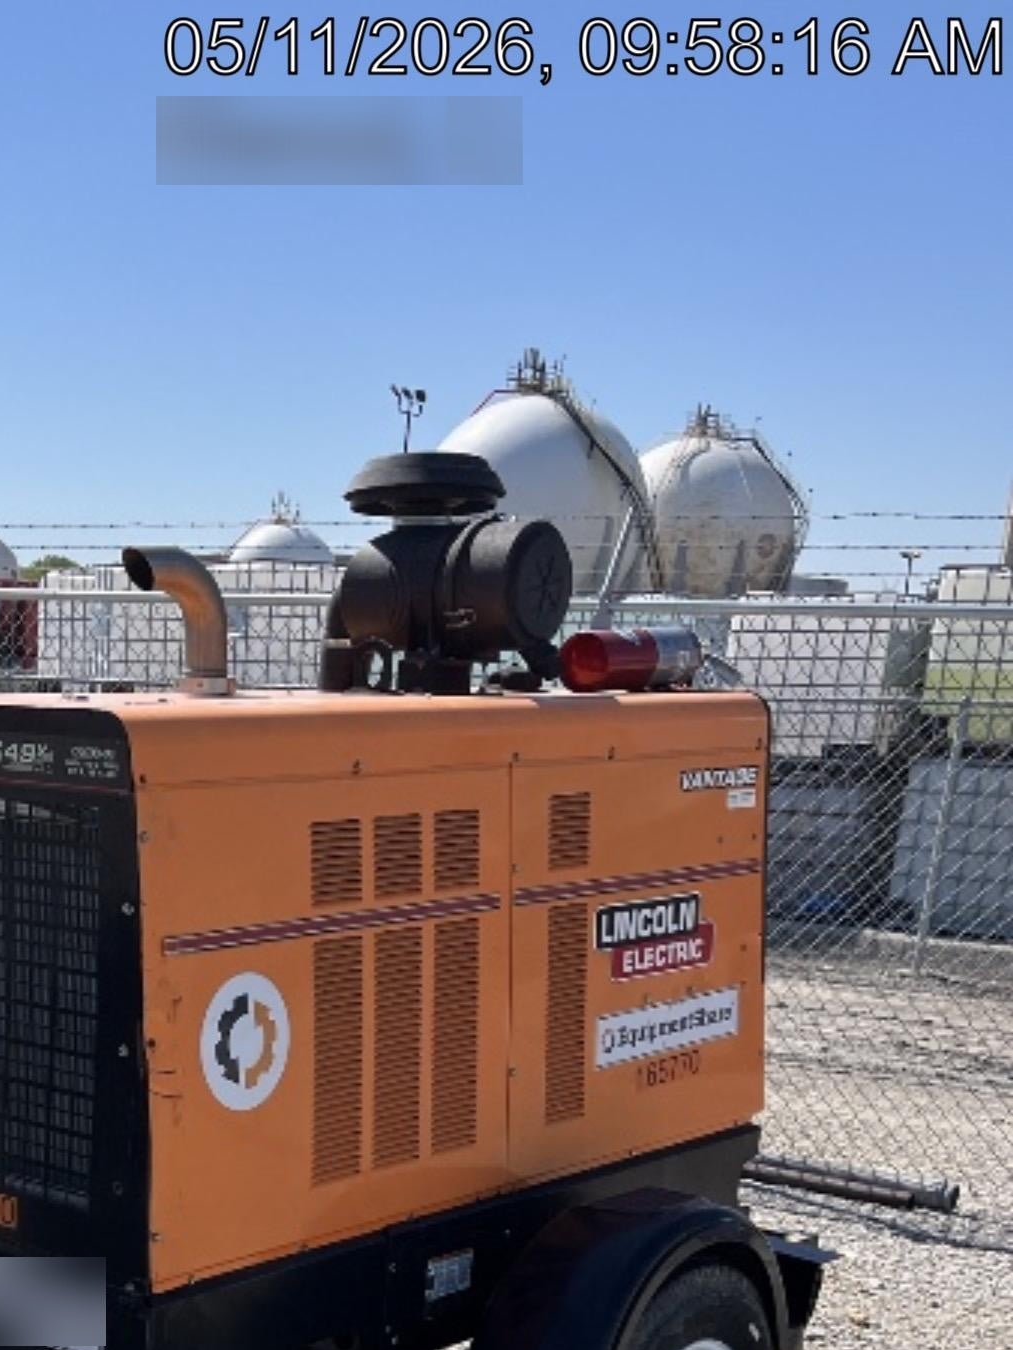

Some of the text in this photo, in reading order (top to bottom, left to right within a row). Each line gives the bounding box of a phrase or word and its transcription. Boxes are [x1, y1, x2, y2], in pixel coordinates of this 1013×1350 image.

[681, 766, 755, 790] VANTAGE
[601, 900, 696, 942] LINCOLN
[622, 938, 702, 973] ELECTRIC
